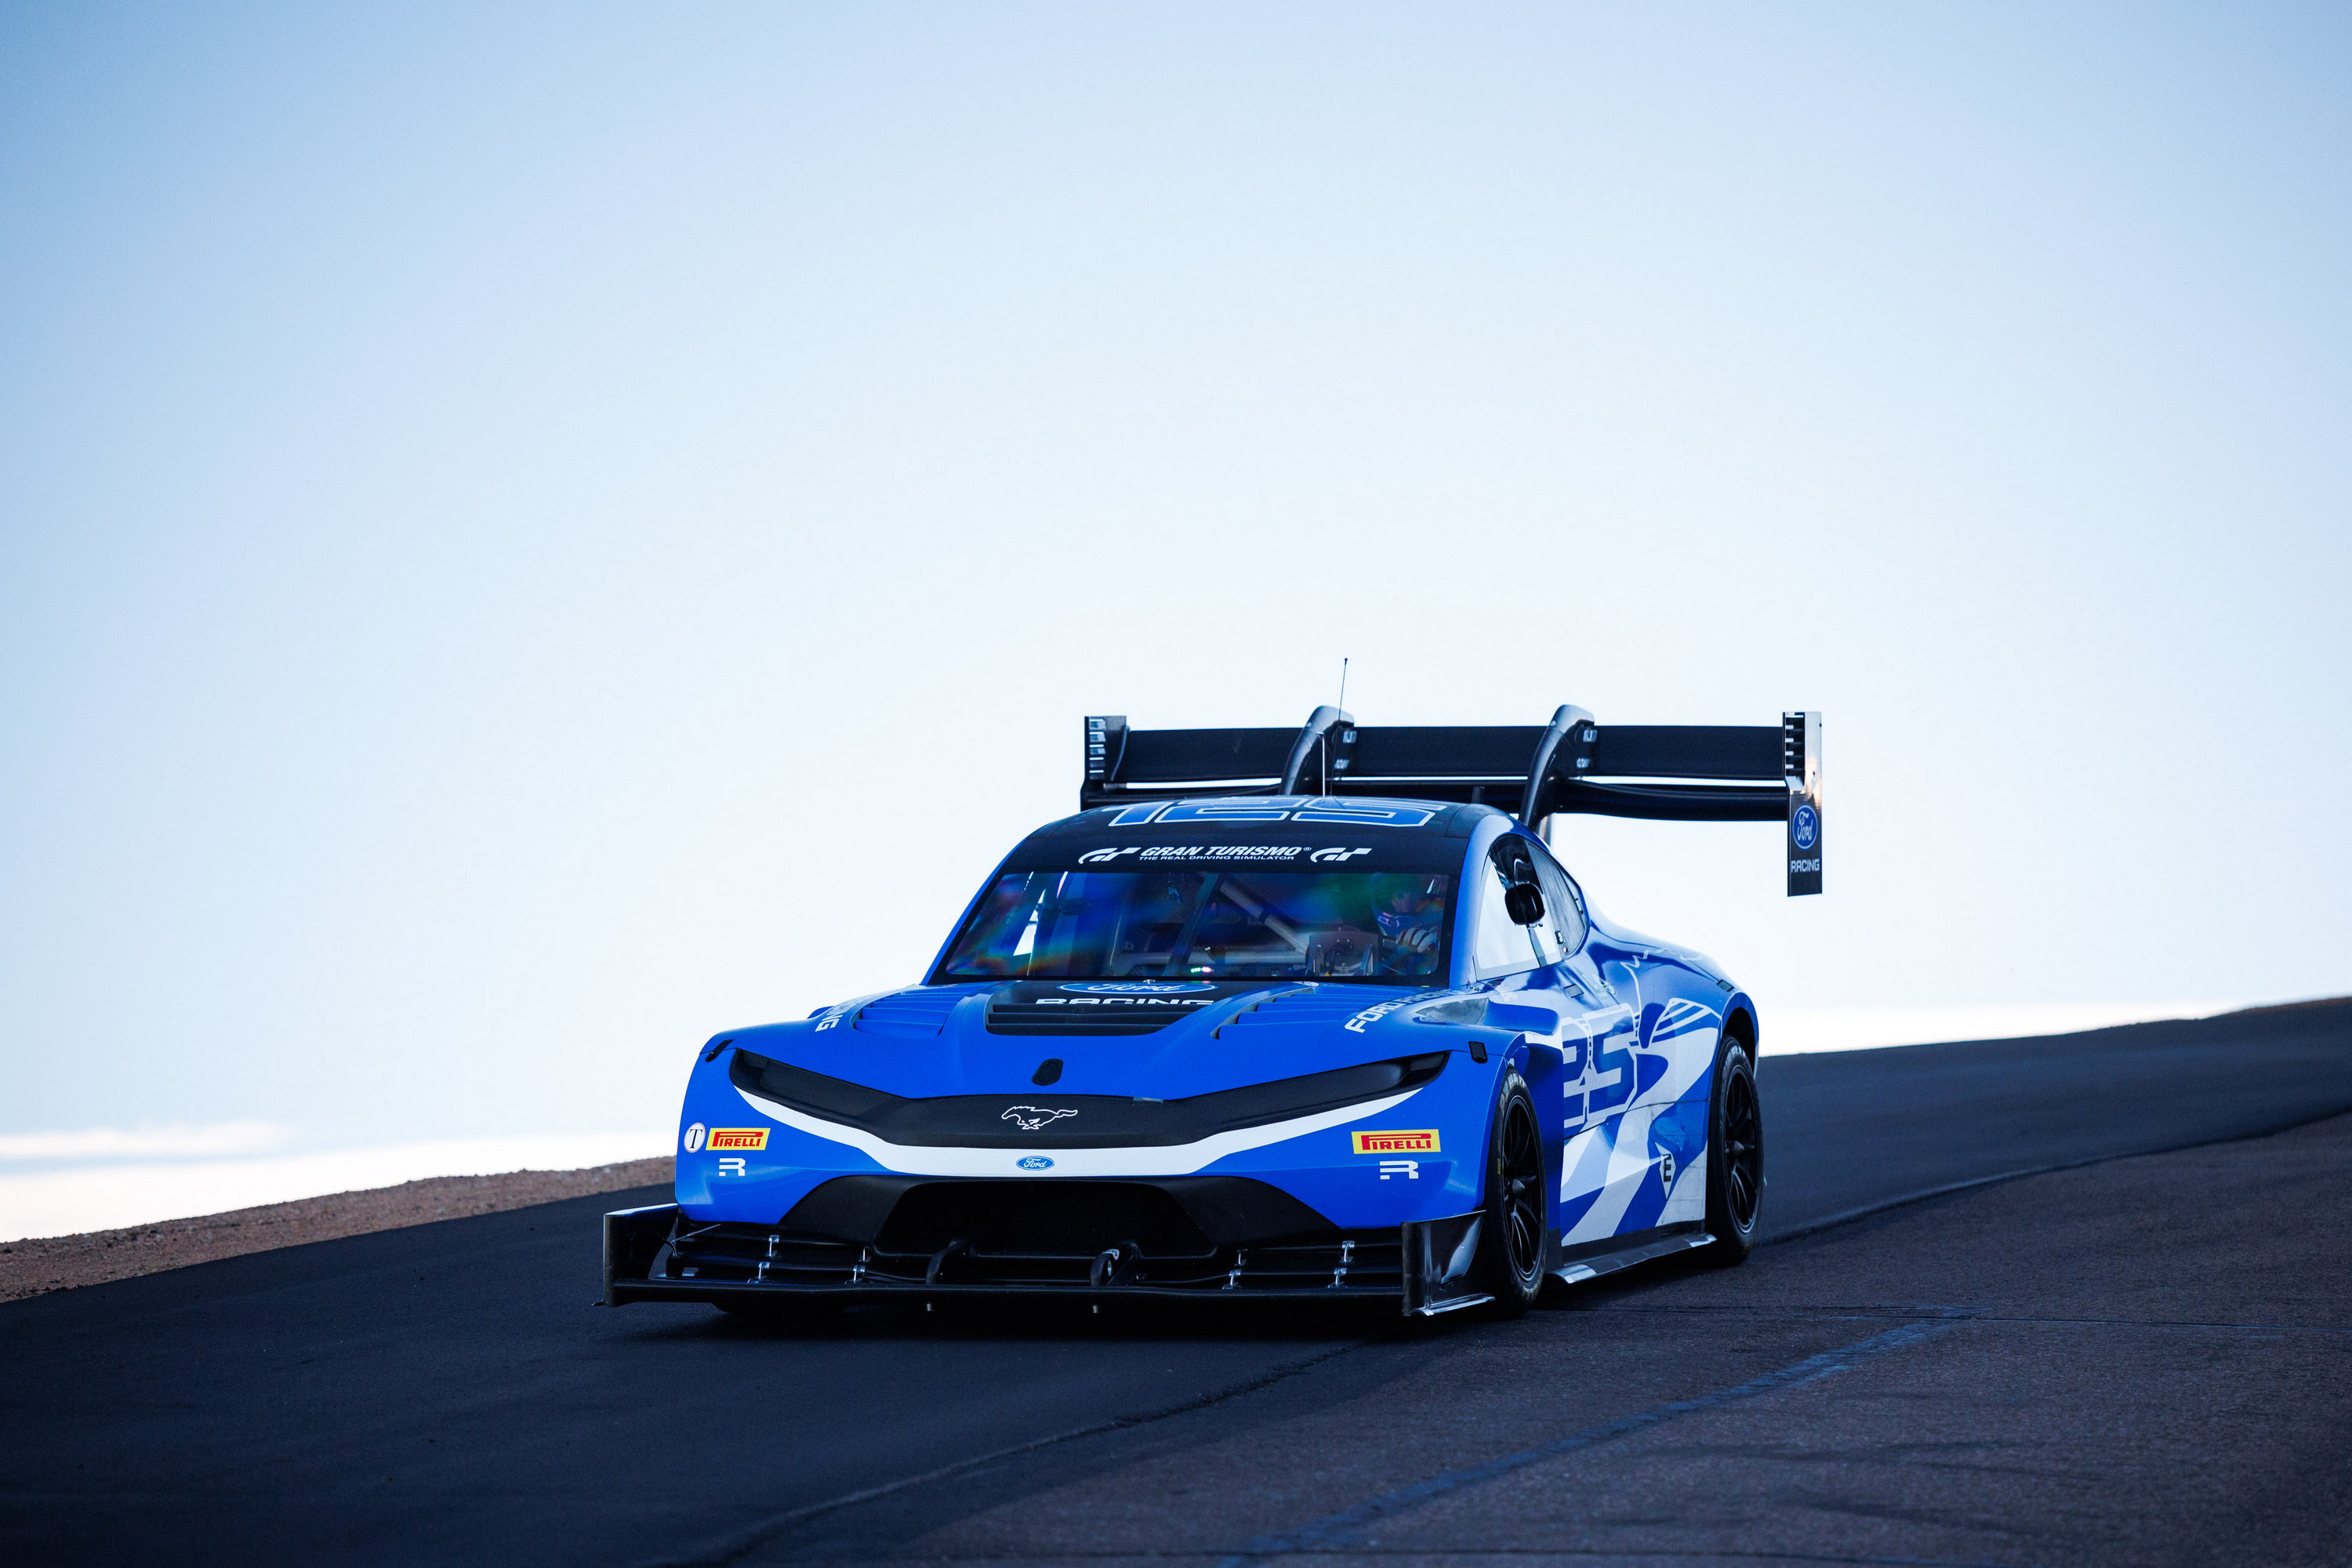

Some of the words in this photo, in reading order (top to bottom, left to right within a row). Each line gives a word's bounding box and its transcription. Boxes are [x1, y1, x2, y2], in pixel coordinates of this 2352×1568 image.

[1101, 795, 1447, 828] 125
[1797, 810, 1813, 841] Ford
[1141, 846, 1204, 856] GRAN
[1791, 858, 1820, 873] RACING
[1344, 1001, 1407, 1033] FORD
[712, 1131, 764, 1147] PIRELLI
[1361, 1133, 1432, 1150] PIRELLI
